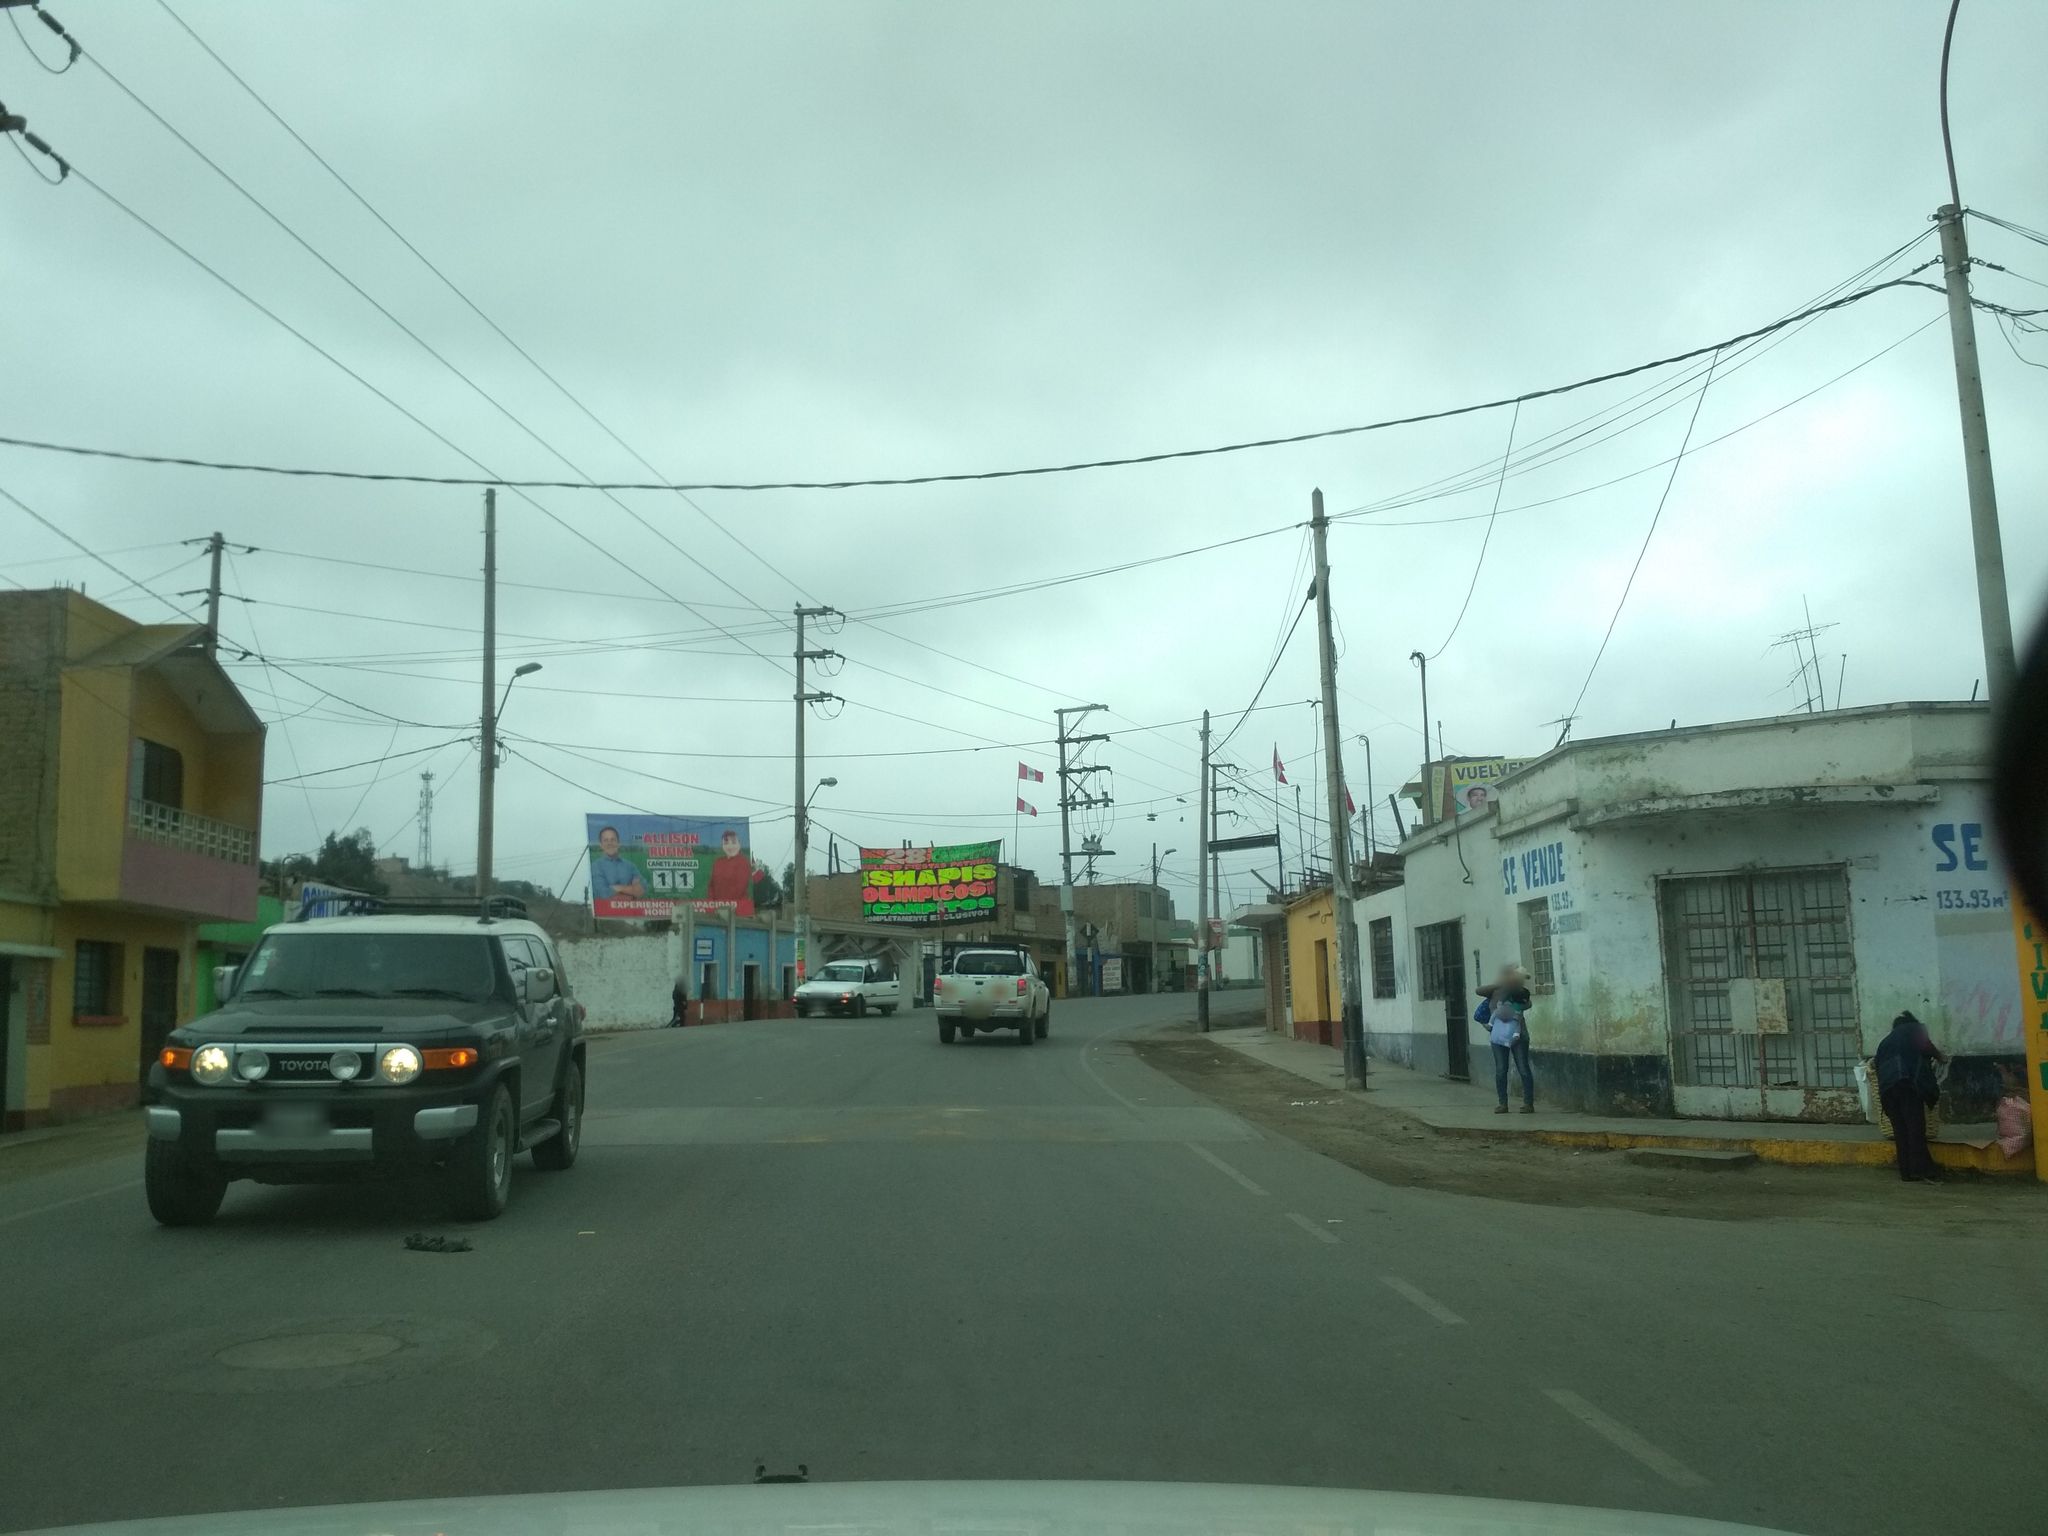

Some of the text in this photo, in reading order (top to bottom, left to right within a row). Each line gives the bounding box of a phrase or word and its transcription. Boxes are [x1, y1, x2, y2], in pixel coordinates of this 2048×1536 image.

[643, 832, 699, 844] ALLISON
[1932, 823, 1988, 872] SE
[648, 860, 698, 868] CAÑETE AVANZA
[1502, 841, 1566, 895] SE VENDE
[868, 864, 997, 886] SHAPIS
[862, 881, 987, 902] OLIMPICOS
[610, 900, 675, 909] EXPERIENCIA
[280, 1060, 330, 1071] TOYOTA
